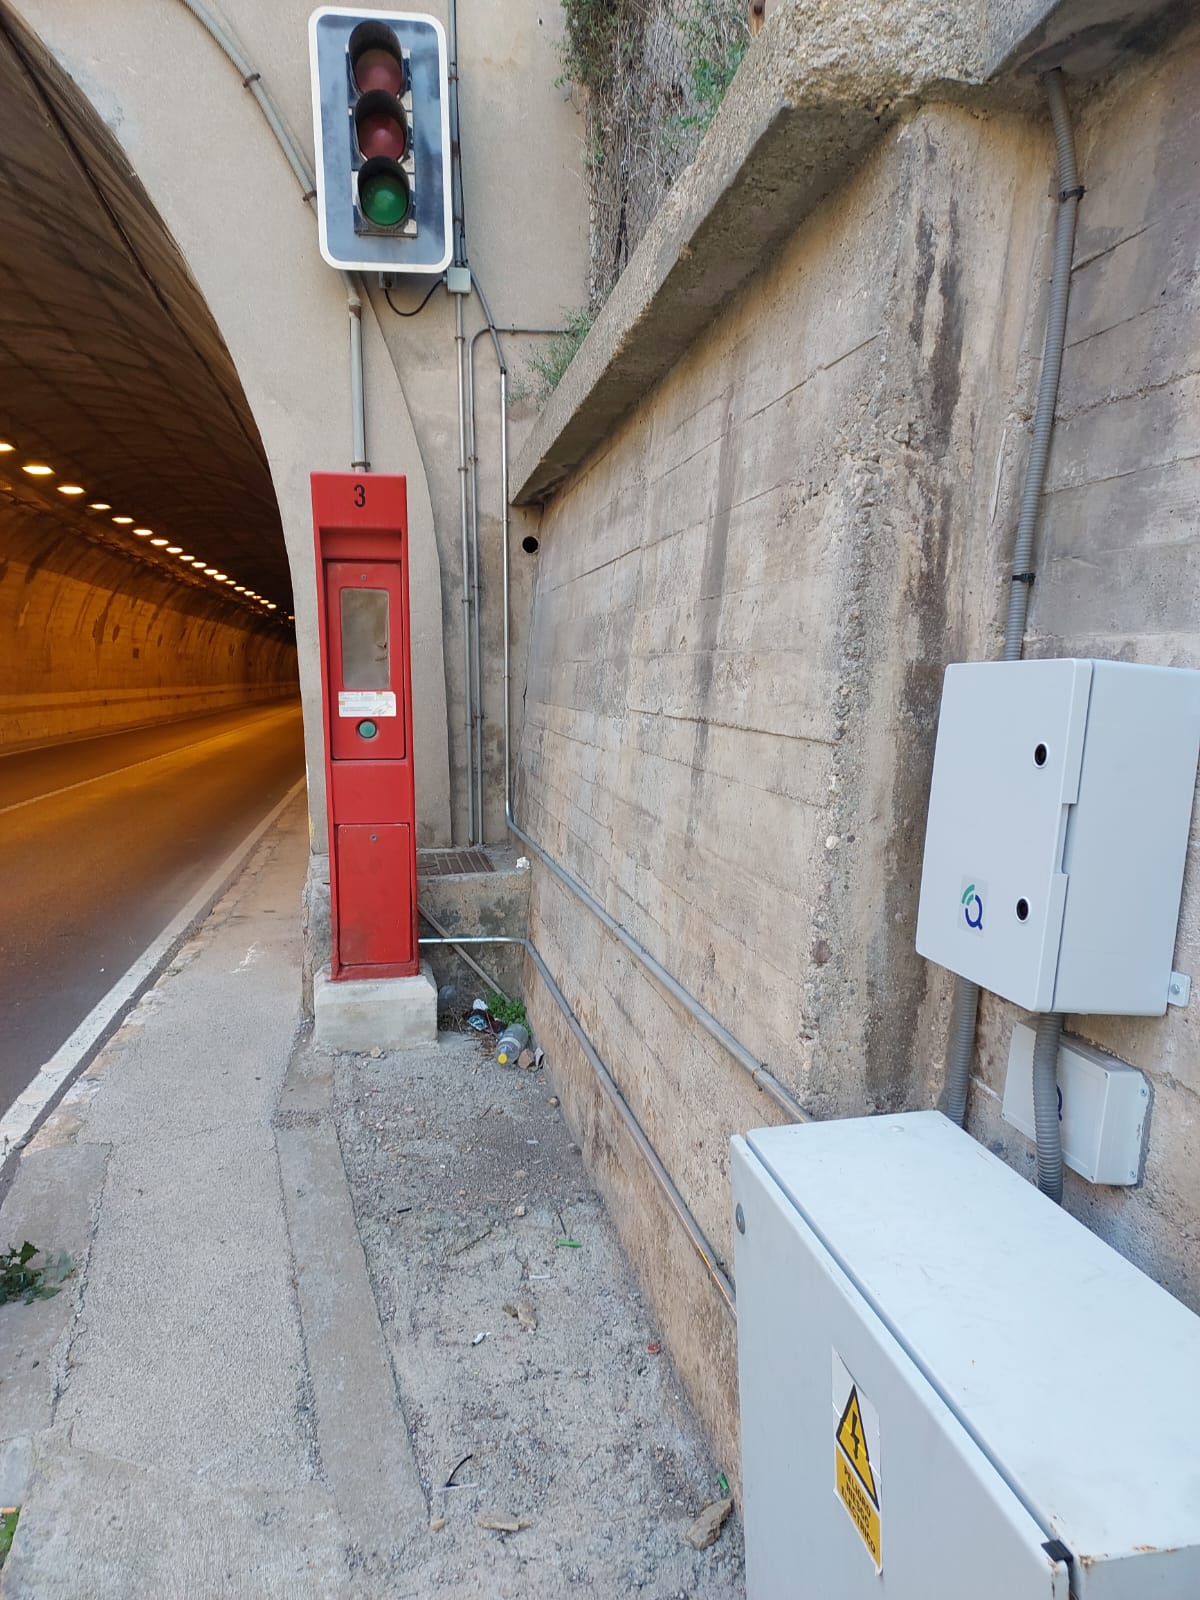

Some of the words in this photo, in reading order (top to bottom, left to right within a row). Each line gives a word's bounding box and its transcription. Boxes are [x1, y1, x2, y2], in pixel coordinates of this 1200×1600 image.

[354, 484, 366, 508] 3
[843, 1463, 871, 1518] PELIGRO
[846, 1480, 870, 1529] RIESGO
